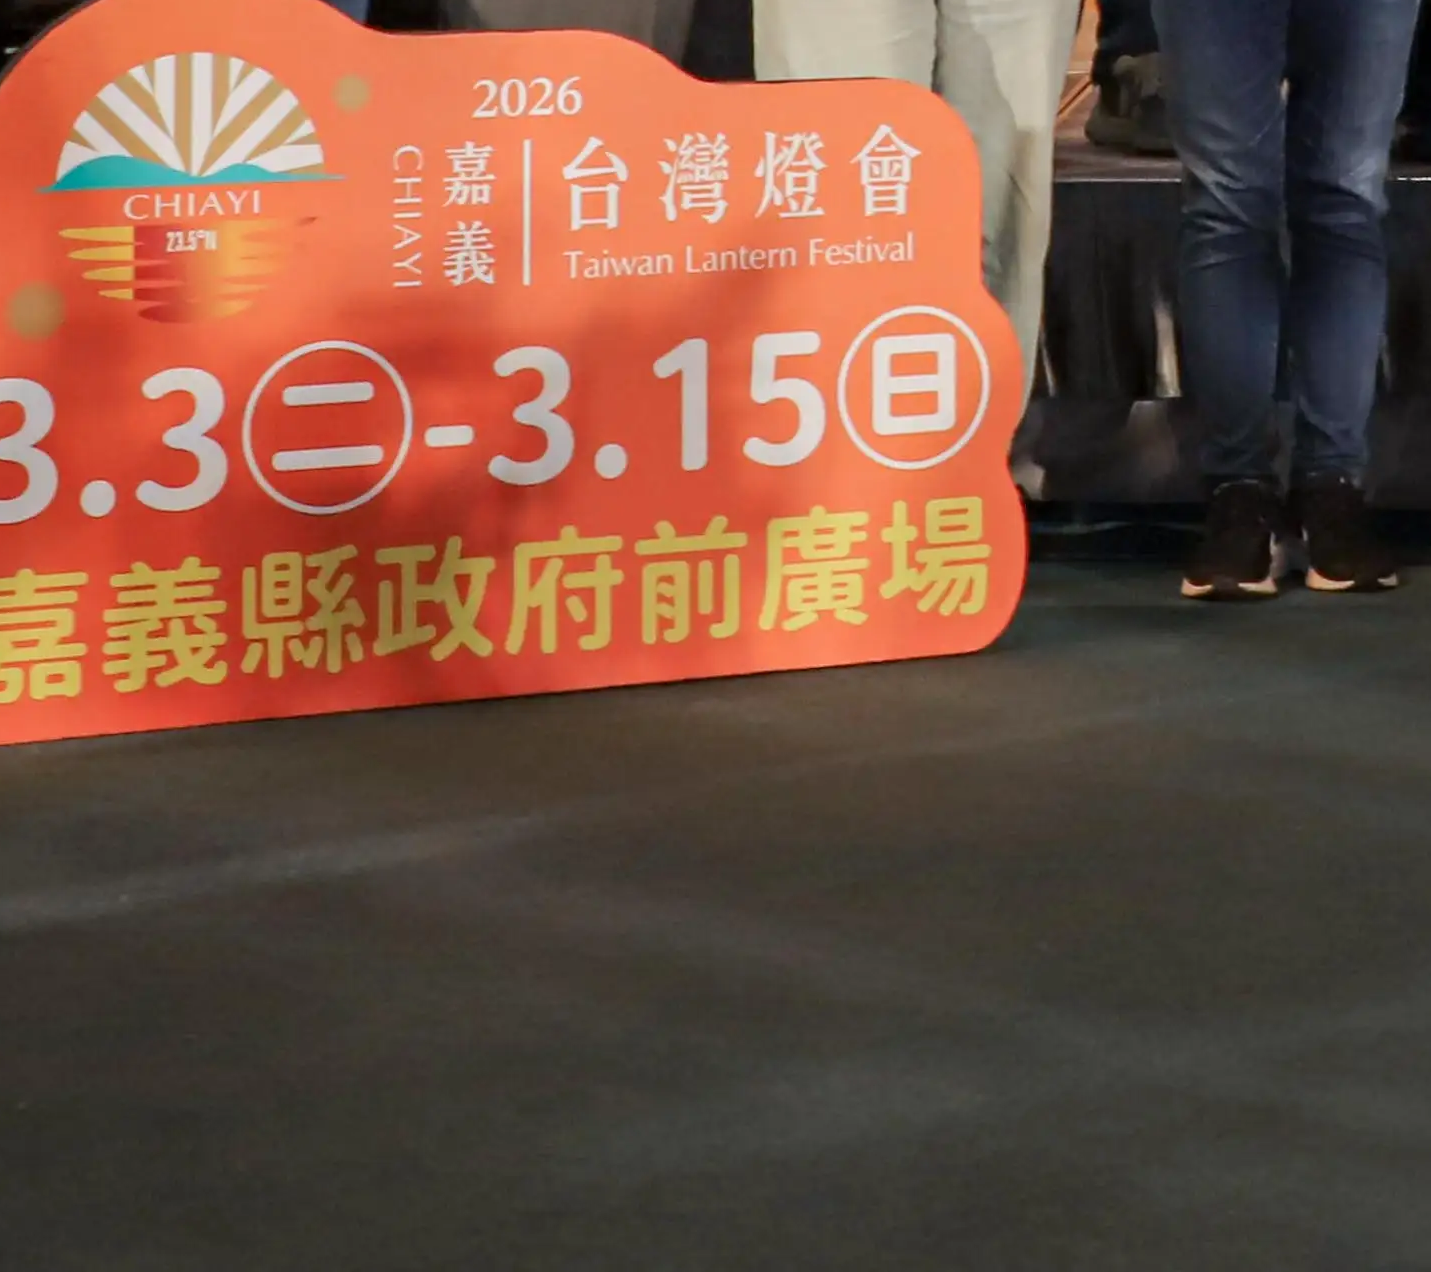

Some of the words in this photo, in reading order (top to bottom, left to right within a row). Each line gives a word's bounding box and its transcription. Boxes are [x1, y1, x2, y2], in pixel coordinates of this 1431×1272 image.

[471, 75, 584, 119] 2026
[122, 189, 262, 221] CHIAYI
[391, 143, 425, 289] CHIAYI
[442, 140, 498, 288] 嘉義
[561, 123, 923, 232] 台灣燈會
[562, 248, 675, 280] Taiwan
[684, 241, 798, 274] Lantern
[807, 230, 916, 267] Festival
